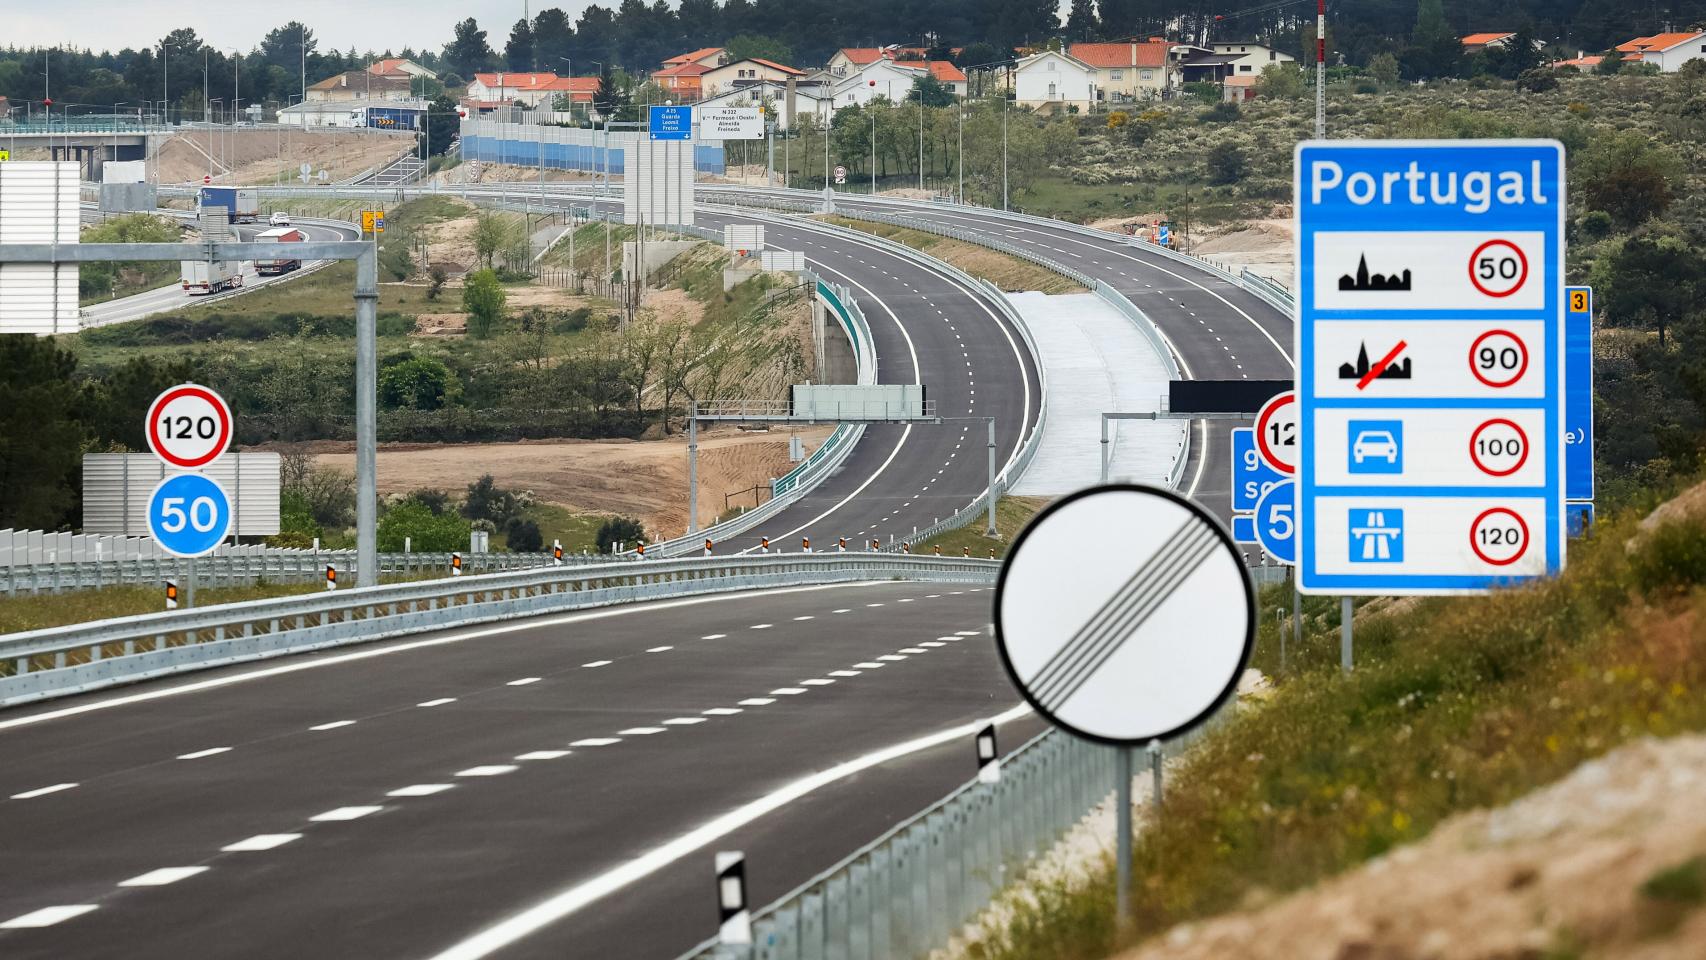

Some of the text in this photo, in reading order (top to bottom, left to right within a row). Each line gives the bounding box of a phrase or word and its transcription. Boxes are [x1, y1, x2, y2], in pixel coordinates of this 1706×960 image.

[1311, 160, 1548, 213] Portugal
[1479, 257, 1518, 280] 50
[1574, 293, 1584, 310] 3
[1479, 347, 1519, 370] 90
[163, 416, 215, 439] 120
[1478, 439, 1521, 457] 100
[160, 495, 218, 533] 50
[1479, 527, 1520, 546] 120
